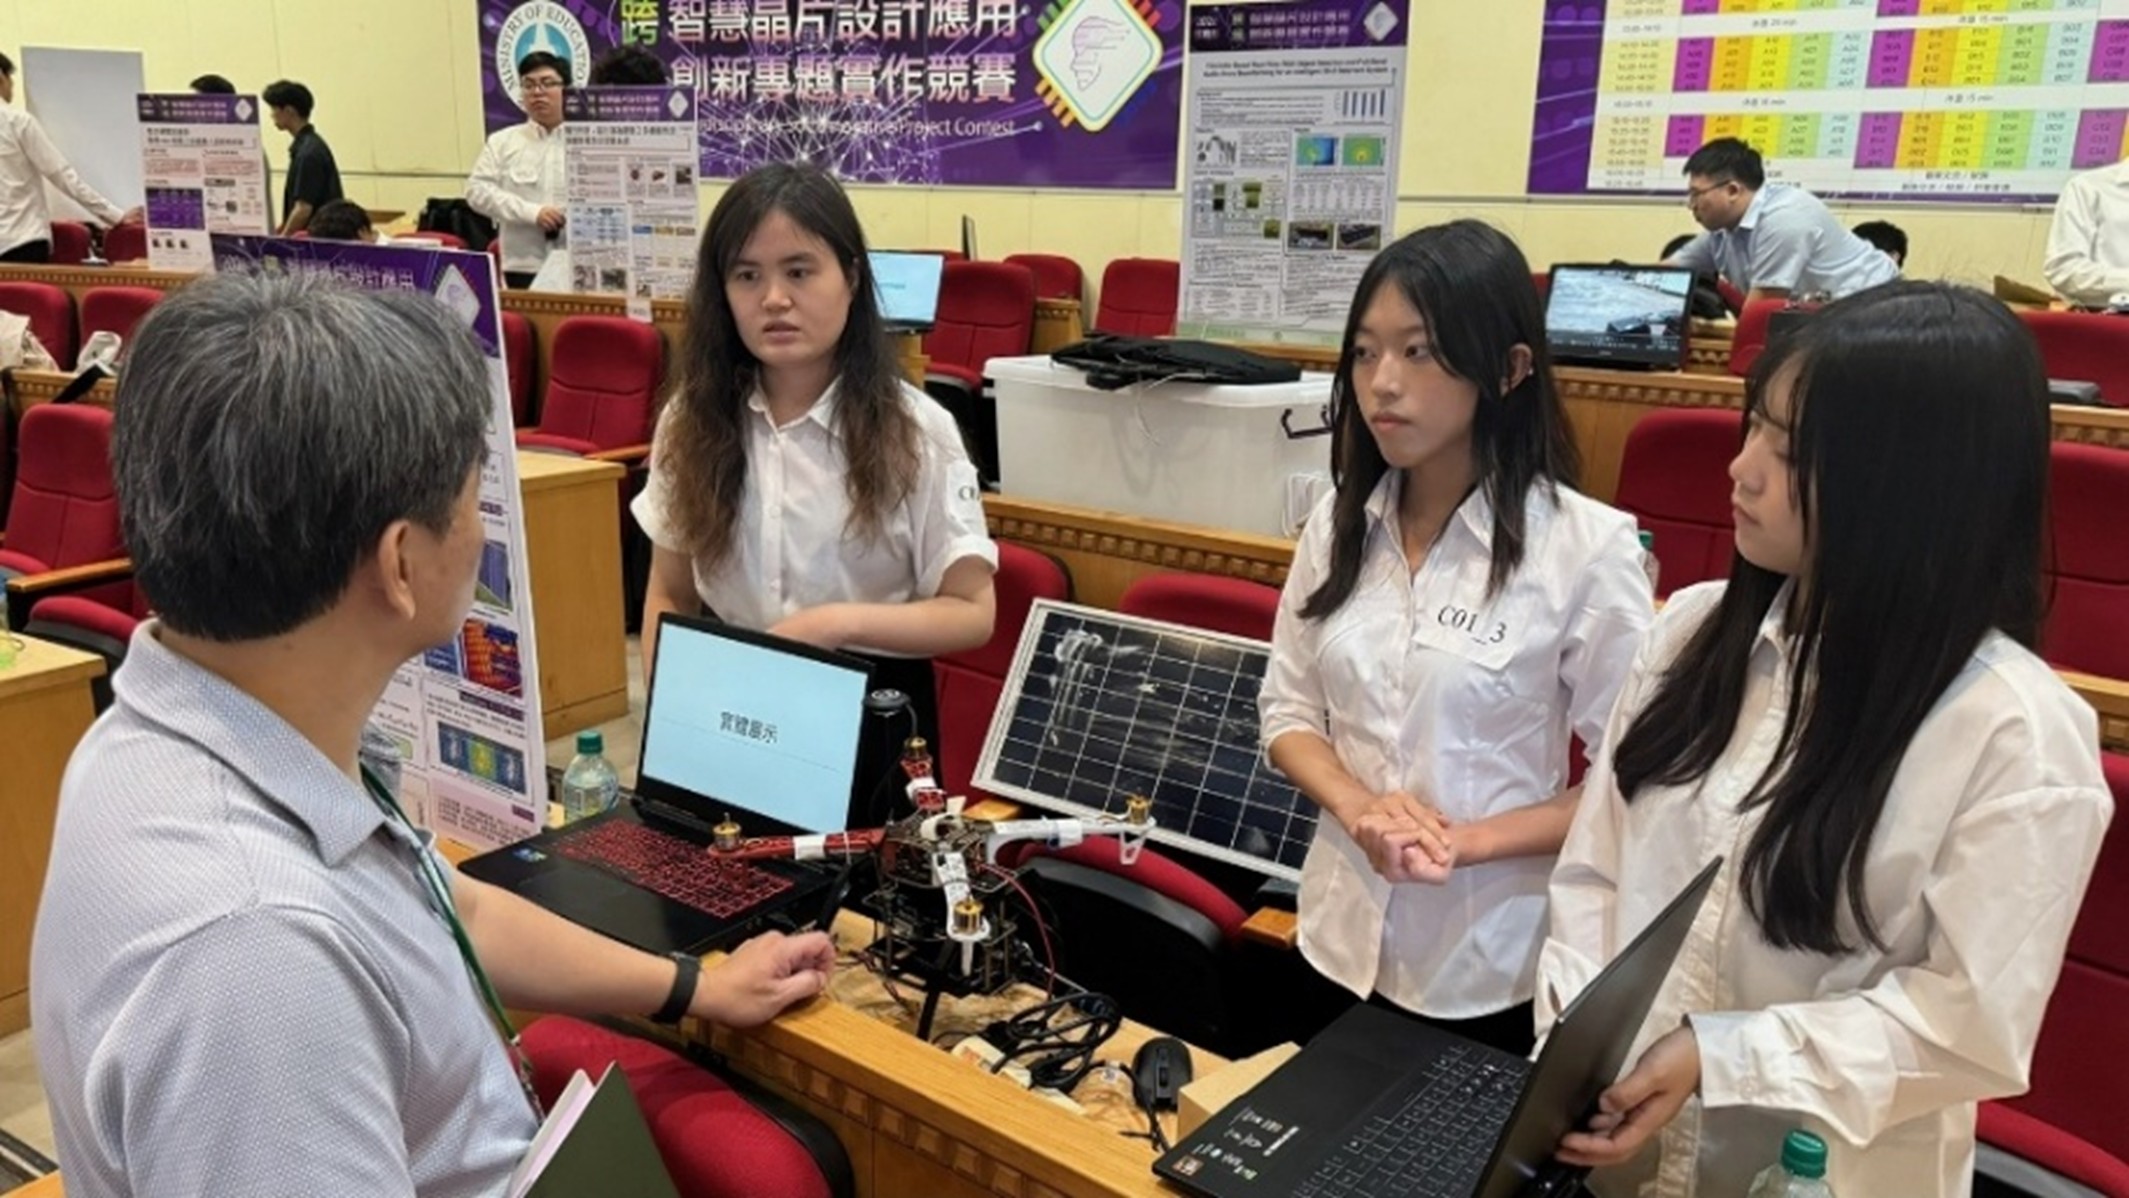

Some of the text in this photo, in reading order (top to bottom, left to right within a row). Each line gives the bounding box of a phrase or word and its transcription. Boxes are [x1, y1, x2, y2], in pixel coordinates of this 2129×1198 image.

[620, 0, 659, 46] 跨
[668, 0, 1016, 44] 智慧晶片設計應用
[500, 4, 587, 90] MINISTRY OF EDUCATIO
[669, 53, 1016, 104] 創新專題實作競賽
[954, 116, 1015, 137] Contest
[1437, 604, 1508, 646] C01_3
[720, 711, 778, 744] 實體展示
